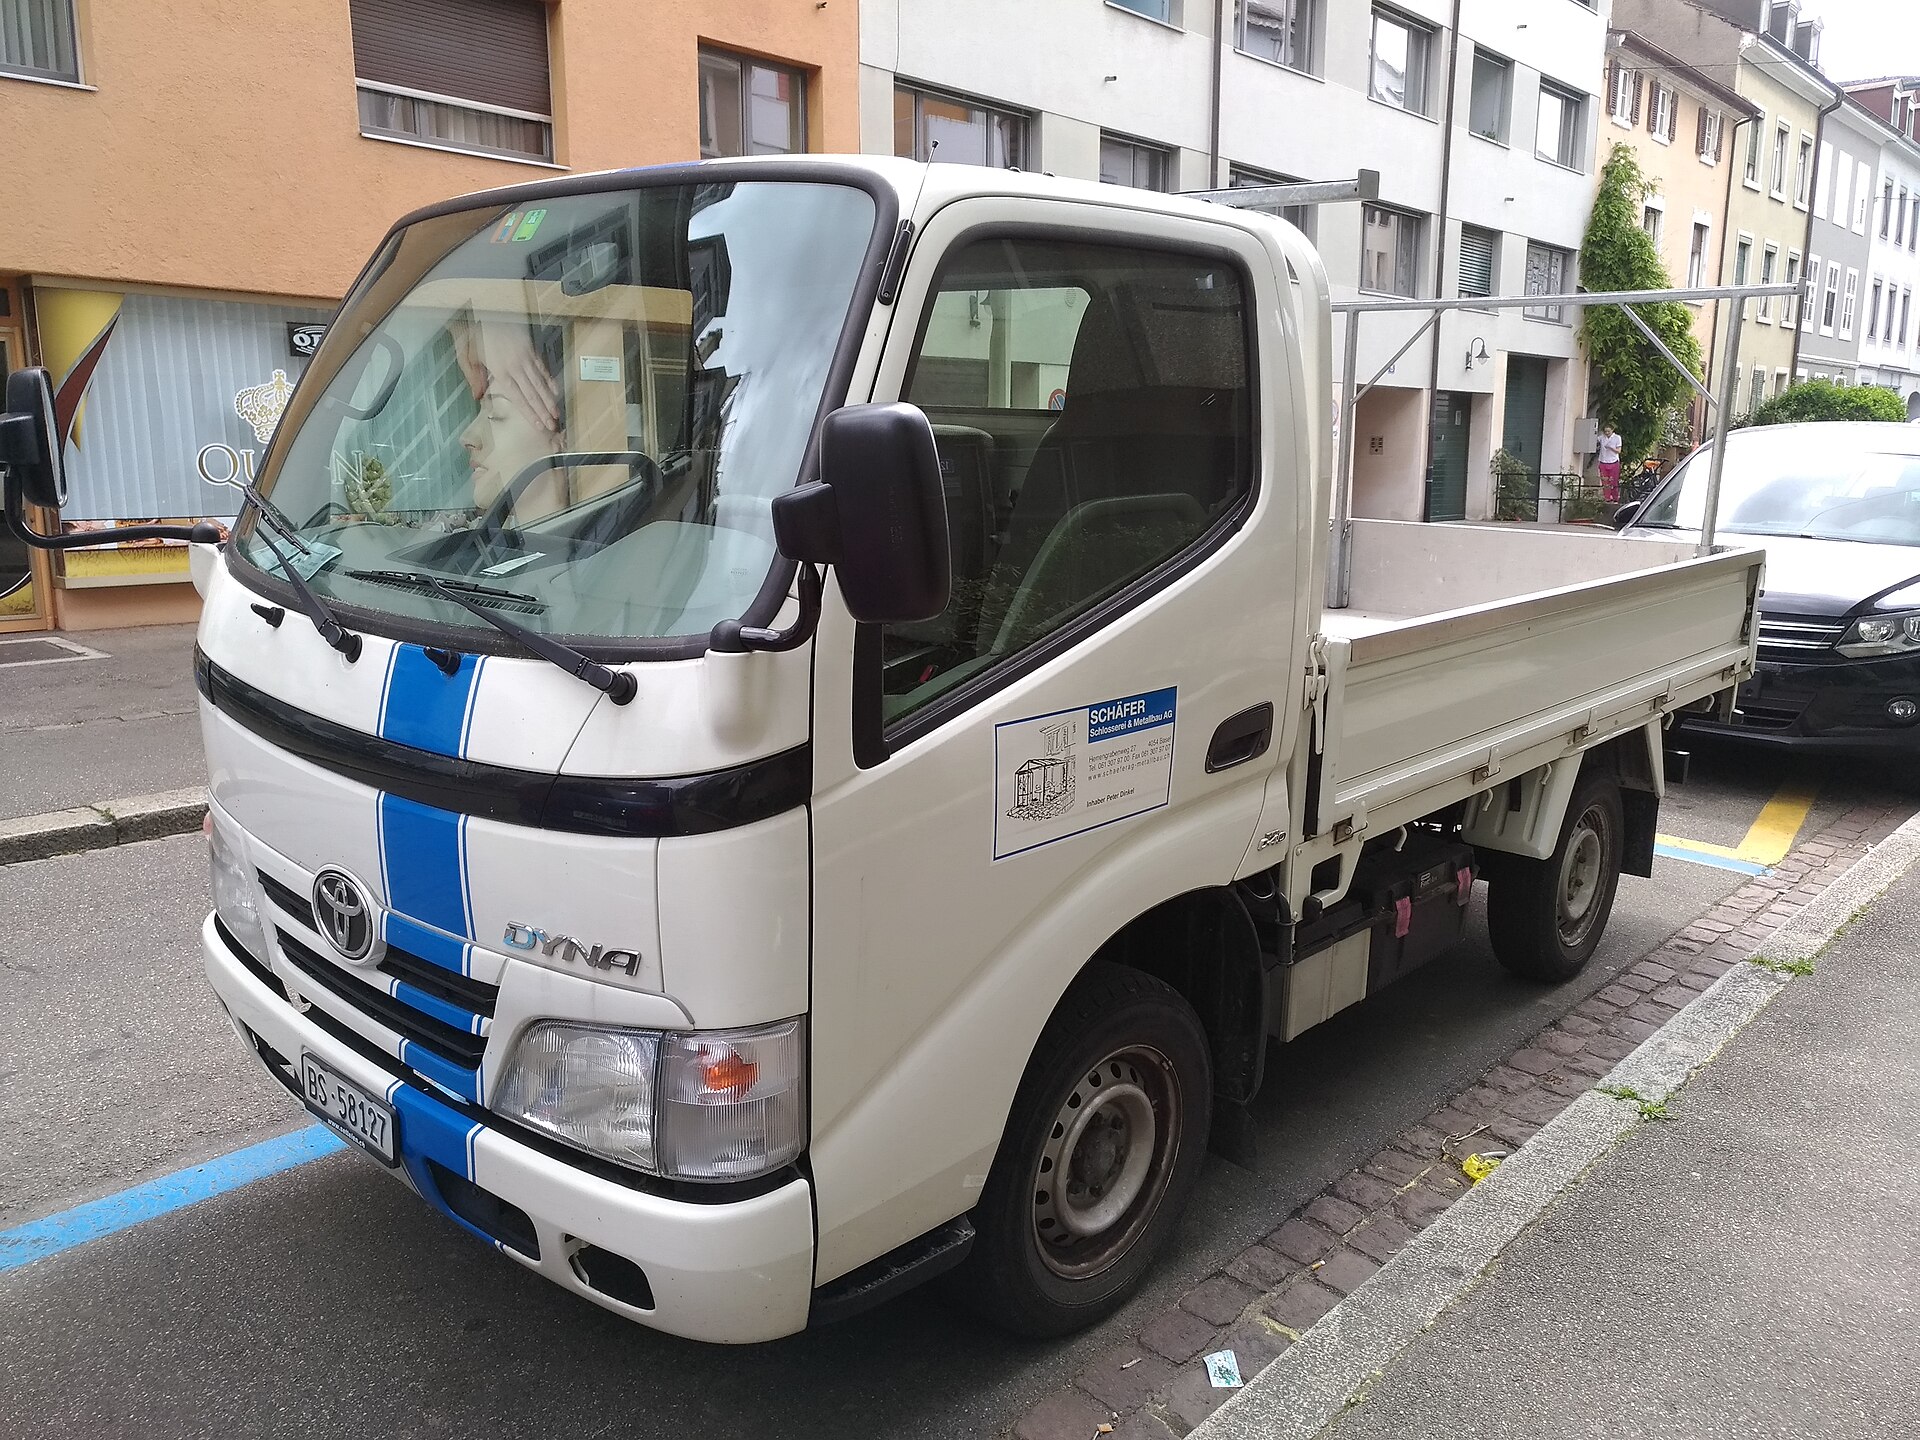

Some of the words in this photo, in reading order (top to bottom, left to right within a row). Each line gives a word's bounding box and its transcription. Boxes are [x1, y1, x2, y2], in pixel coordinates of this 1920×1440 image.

[1089, 720, 1127, 738] Schlosserei
[1127, 719, 1133, 728] &
[1133, 713, 1163, 727] Metallbau
[1163, 709, 1173, 720] AG
[1090, 699, 1146, 725] SCHÄFER
[1086, 797, 1106, 808] Inhaber
[1106, 793, 1120, 803] Peter
[1119, 787, 1135, 798] Dinkel
[503, 920, 643, 977] DYNA
[337, 1083, 386, 1149] 58127
